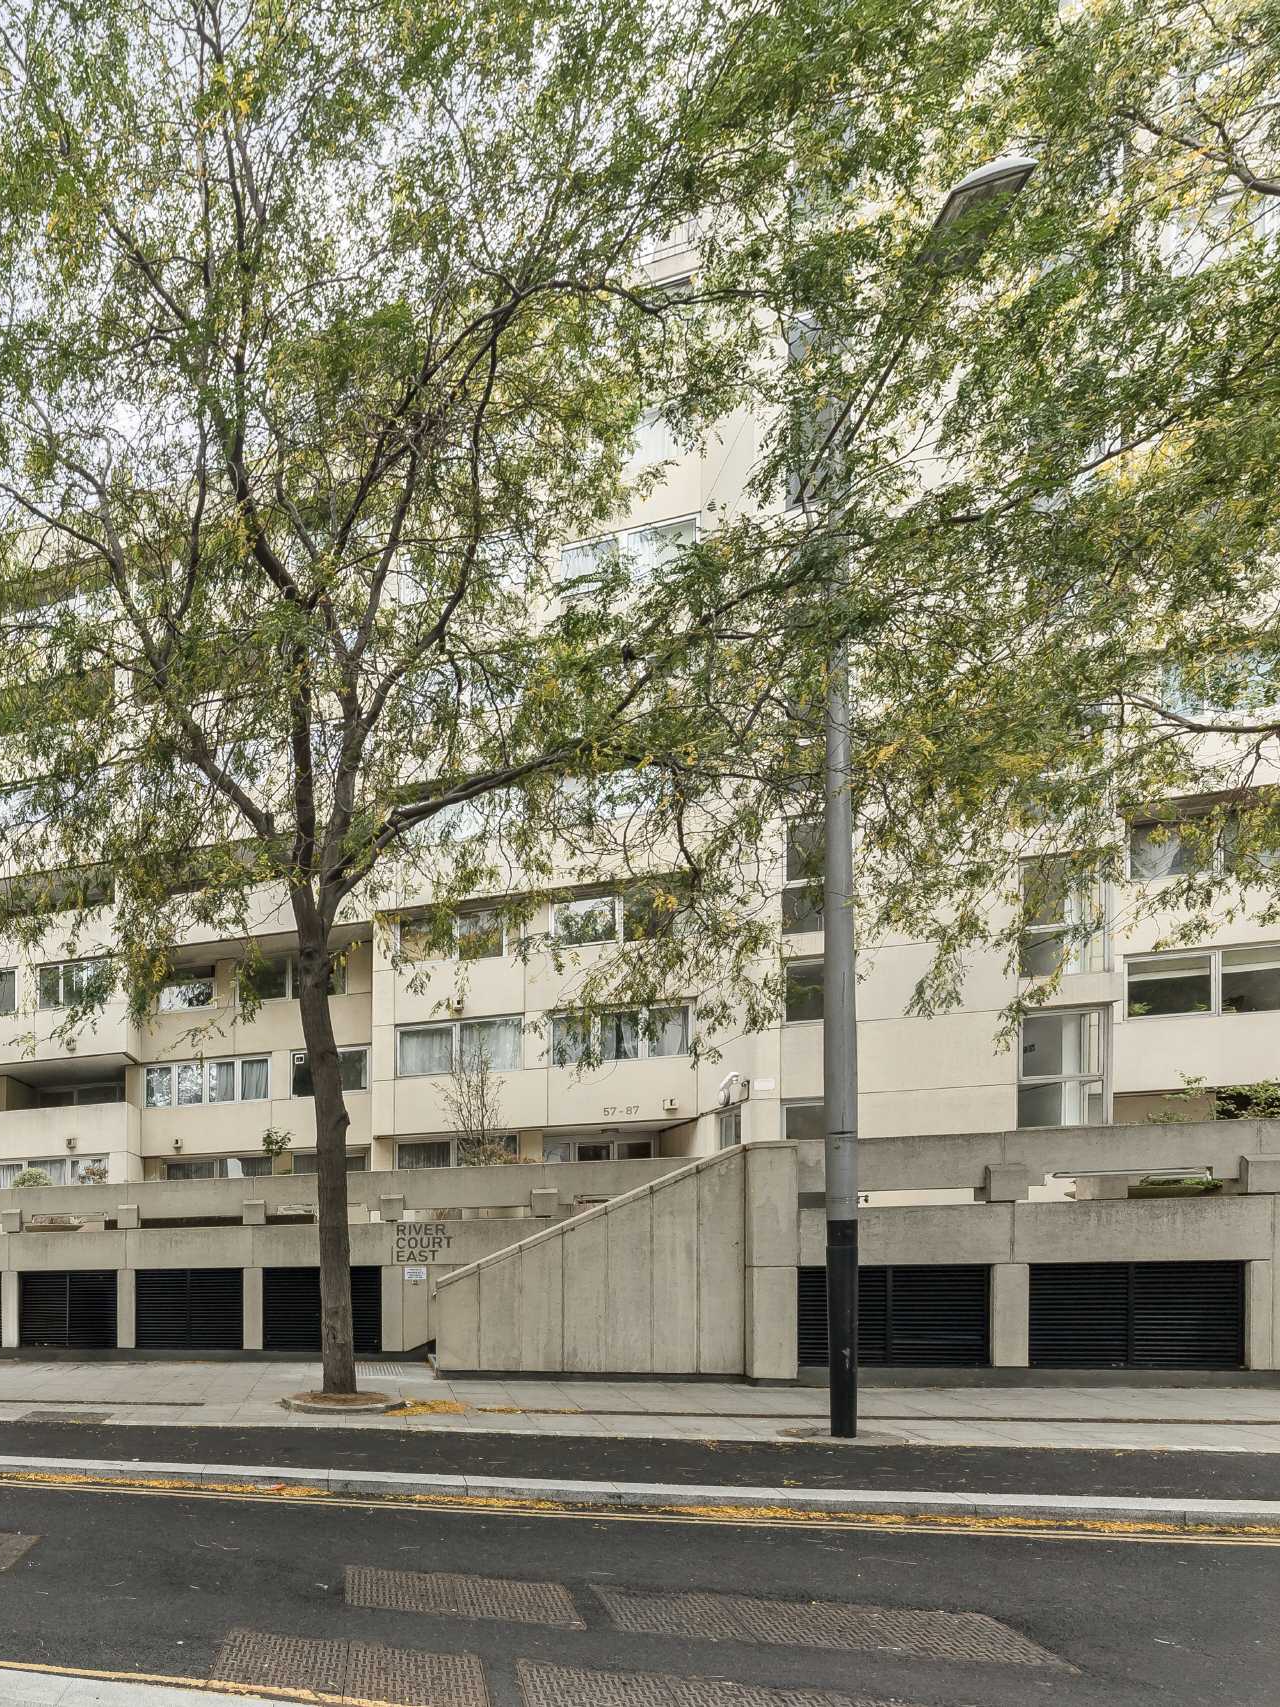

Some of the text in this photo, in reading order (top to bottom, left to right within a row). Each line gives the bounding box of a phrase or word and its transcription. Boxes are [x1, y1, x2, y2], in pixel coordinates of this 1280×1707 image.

[396, 1224, 447, 1236] RIVER
[396, 1236, 454, 1249] COURT
[396, 1249, 439, 1262] EAST
